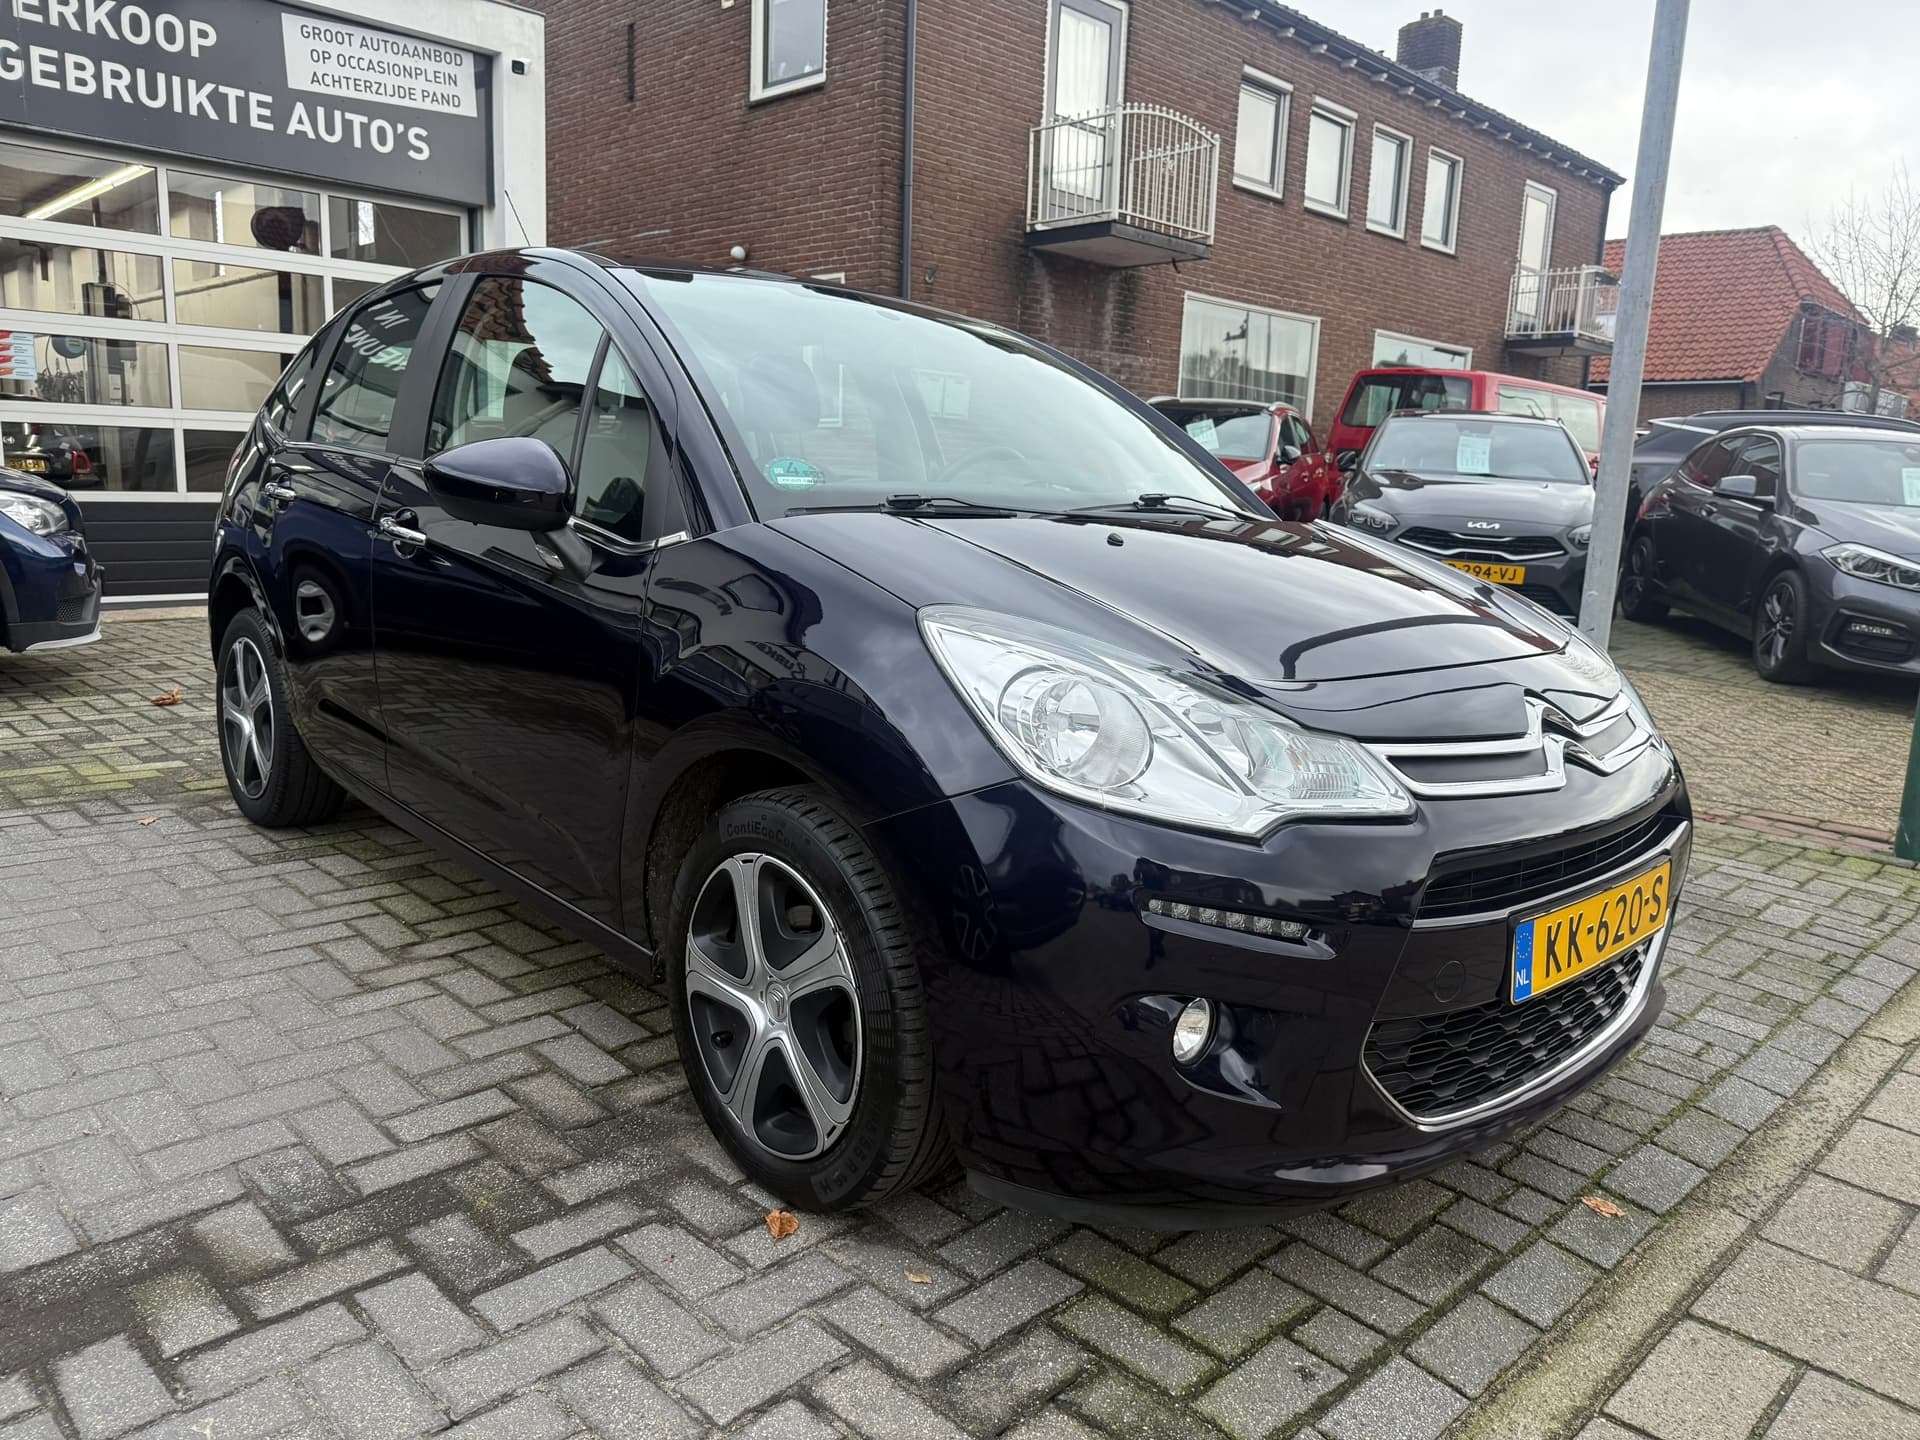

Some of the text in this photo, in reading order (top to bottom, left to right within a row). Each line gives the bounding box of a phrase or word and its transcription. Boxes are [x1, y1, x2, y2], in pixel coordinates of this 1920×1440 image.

[300, 24, 463, 67] GROOT AUTOAANBOD
[310, 48, 459, 87] OP OCCASIONPLEIN
[0, 39, 431, 161] GEBRUIKTE AUTO'S
[310, 71, 462, 108] ACHTERZIJDE PAND
[1544, 873, 1663, 979] KK-620-S
[1515, 970, 1530, 987] NL
